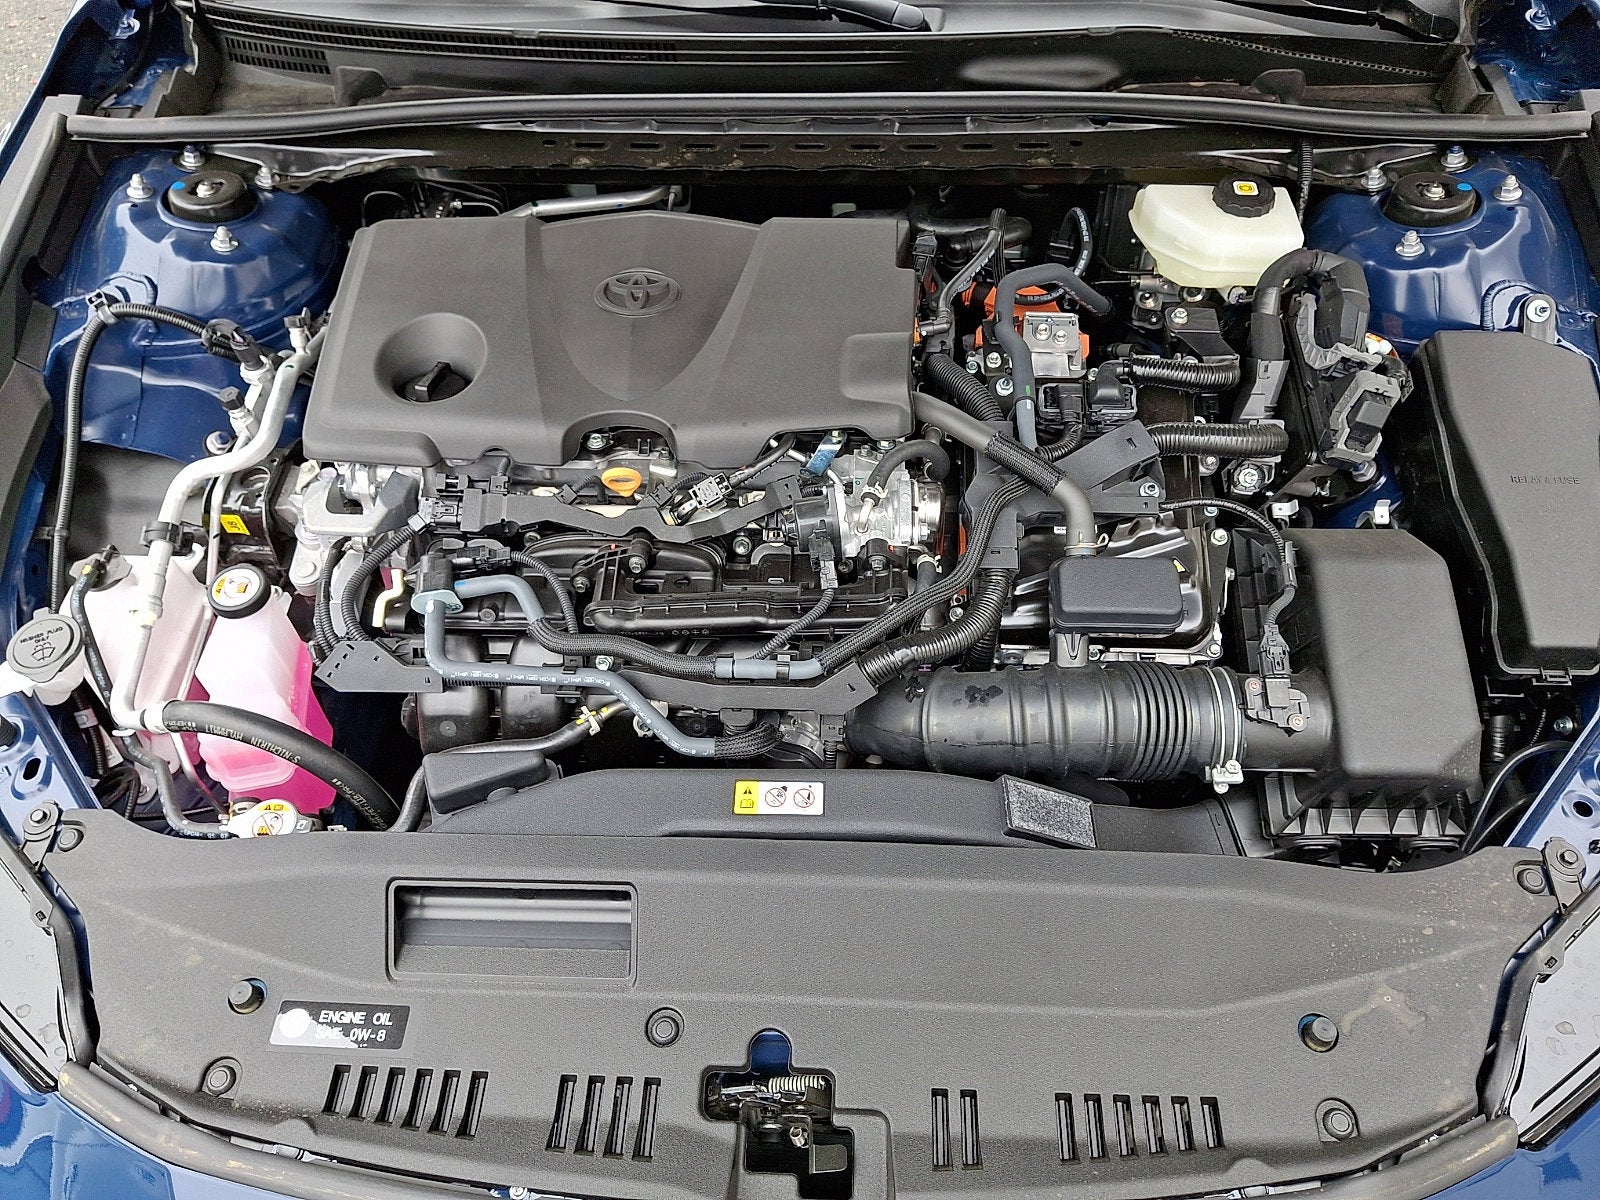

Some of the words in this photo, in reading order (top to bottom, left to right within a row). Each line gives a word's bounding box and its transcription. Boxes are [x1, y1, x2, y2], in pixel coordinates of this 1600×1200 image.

[1510, 475, 1542, 484] RELAY
[1553, 476, 1581, 485] FUSE
[319, 1010, 367, 1025] ENGINE
[373, 1013, 393, 1026] OIL
[349, 1028, 387, 1042] 0W-8
